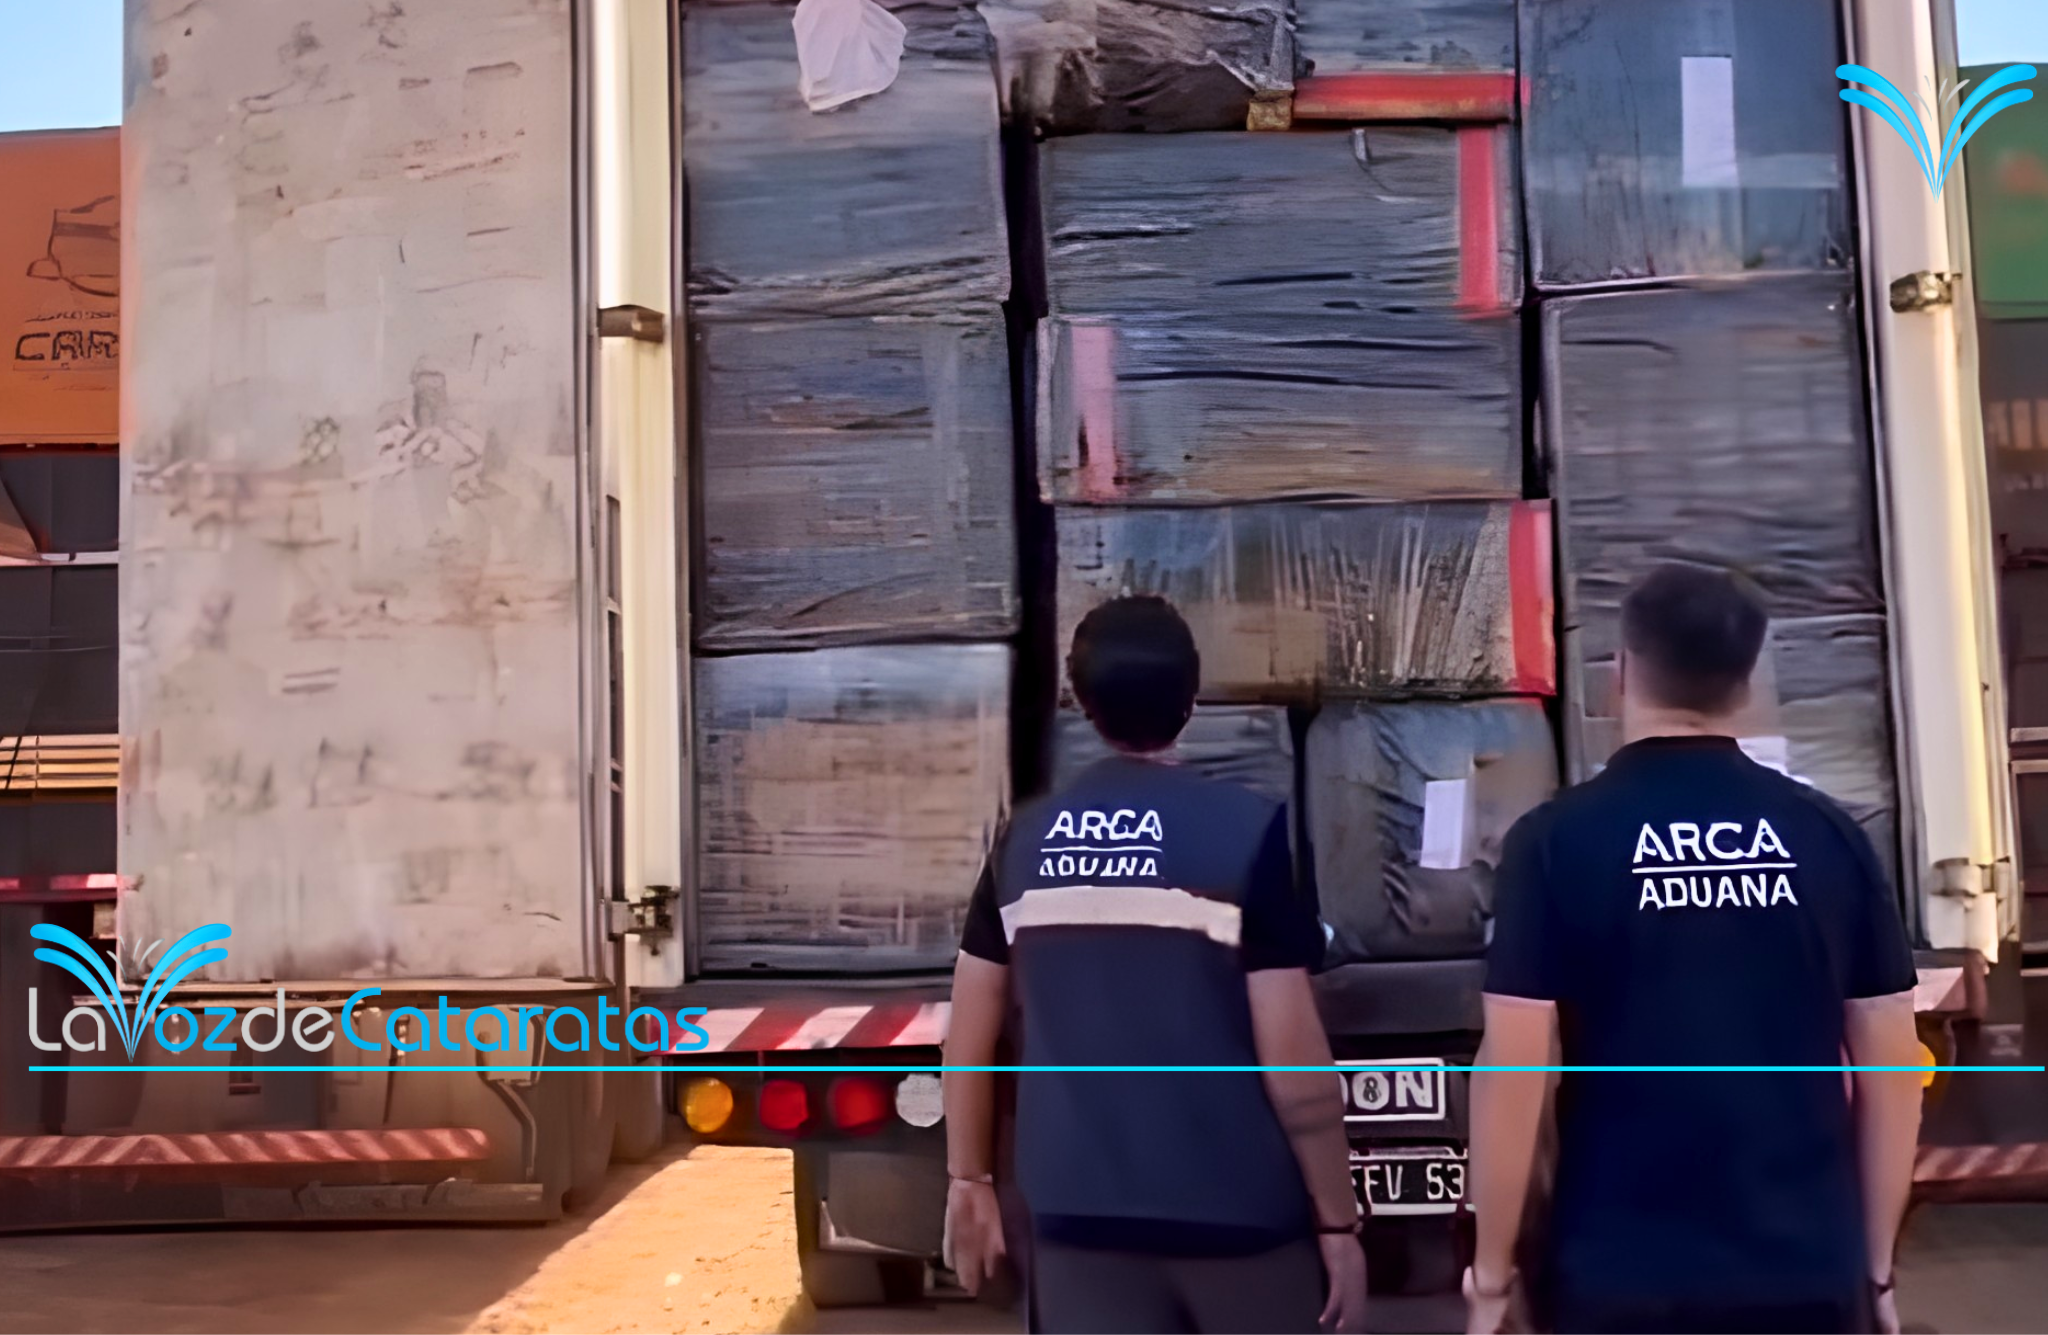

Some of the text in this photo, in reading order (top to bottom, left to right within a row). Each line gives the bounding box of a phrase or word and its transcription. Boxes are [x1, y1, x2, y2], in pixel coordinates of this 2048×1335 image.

[1044, 808, 1163, 842] ARCA
[1632, 817, 1791, 864] ARCA
[1638, 873, 1799, 911] ADUANA
